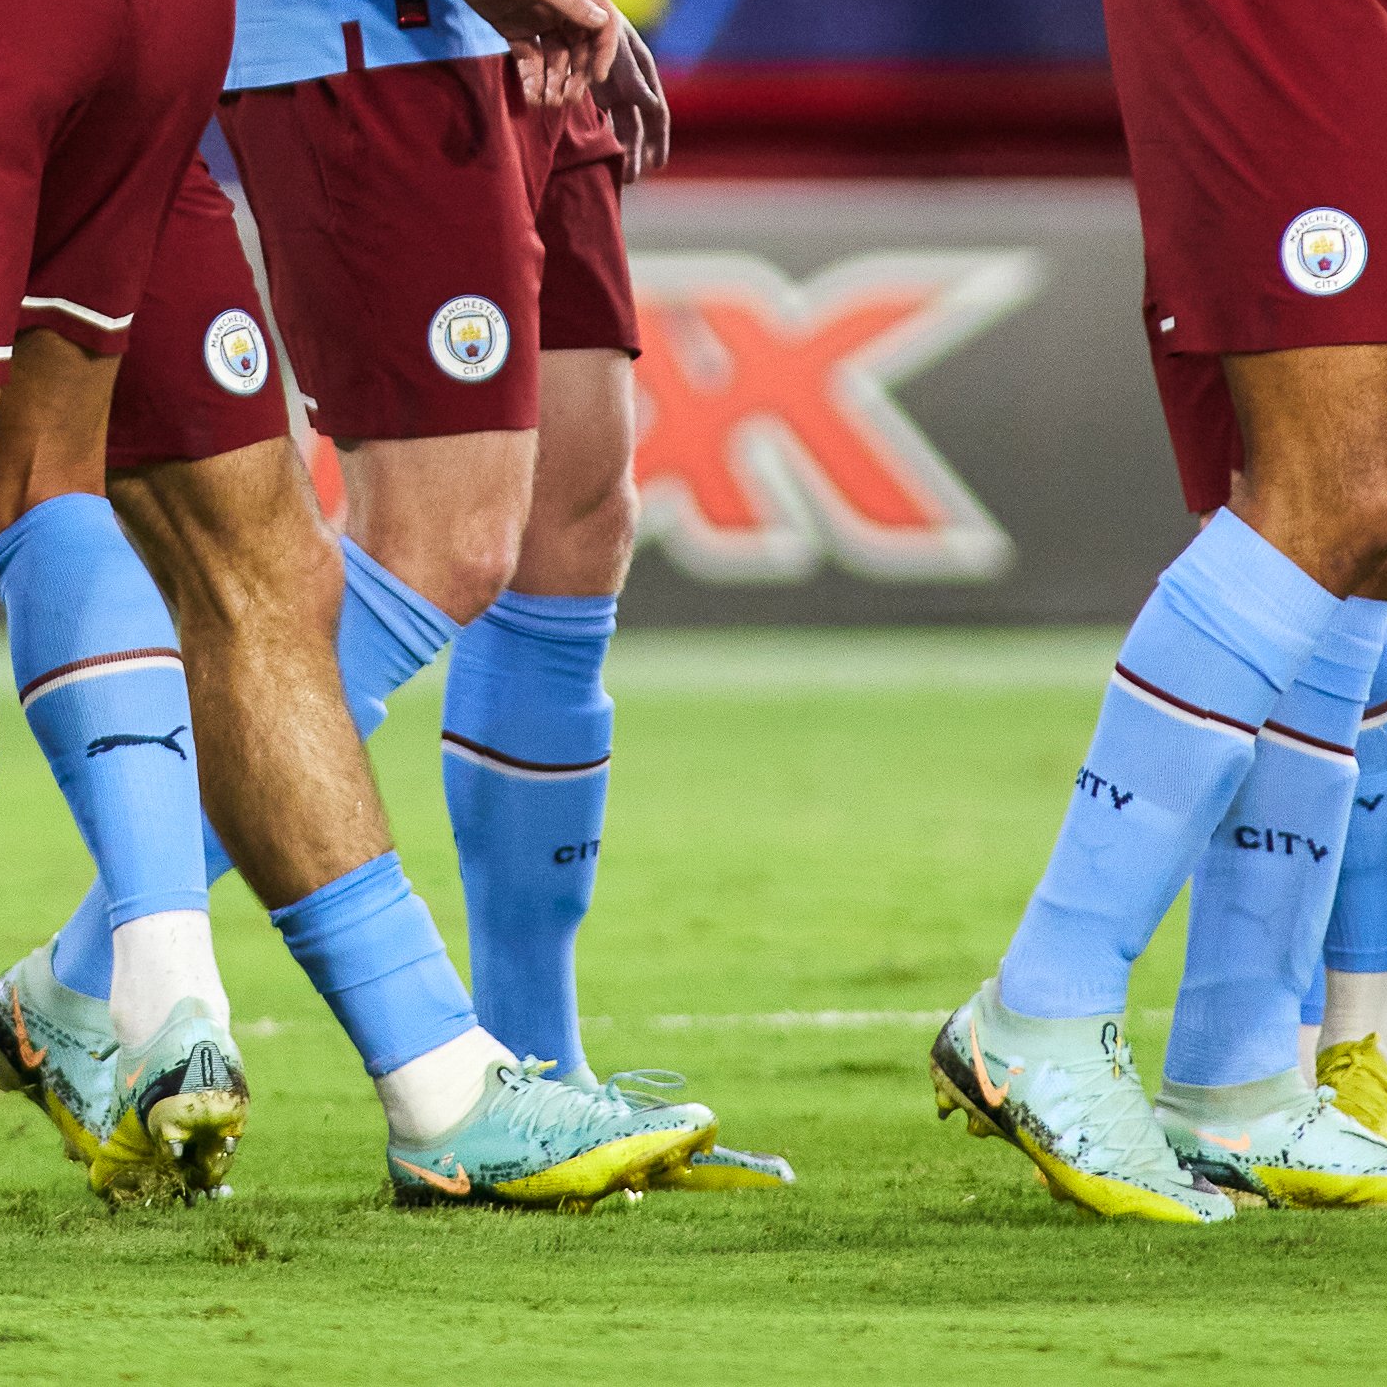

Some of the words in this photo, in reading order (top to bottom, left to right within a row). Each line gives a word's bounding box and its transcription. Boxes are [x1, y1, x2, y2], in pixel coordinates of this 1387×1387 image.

[1290, 213, 1357, 243] MANCHESTER
[1314, 280, 1339, 289] CITY
[437, 300, 502, 330] MANCHESTER
[463, 366, 487, 375] CITY
[554, 840, 601, 865] CIT
[1234, 825, 1329, 863] CITY
